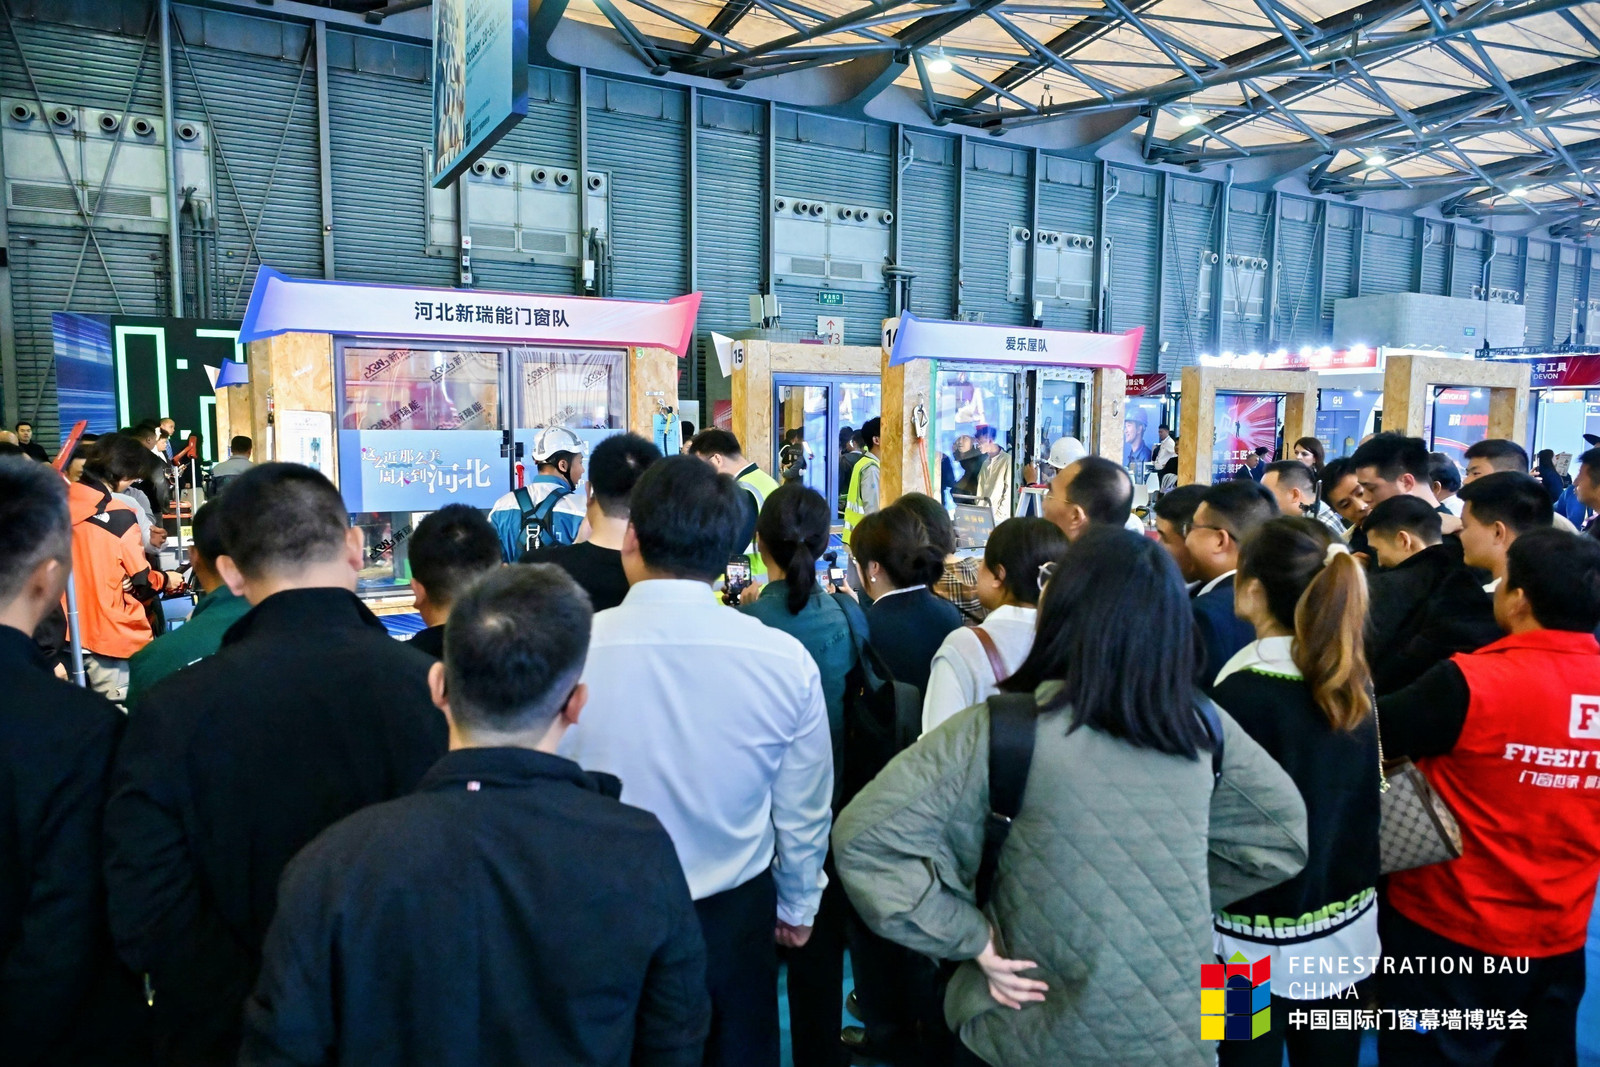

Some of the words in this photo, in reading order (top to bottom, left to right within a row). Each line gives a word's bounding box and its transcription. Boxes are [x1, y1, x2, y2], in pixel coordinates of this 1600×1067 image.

[414, 301, 570, 328] 河北新瑞能门窗队
[1005, 336, 1049, 353] 爱乐屋队
[733, 348, 744, 364] 15
[360, 447, 442, 469] 这么近那么美
[379, 458, 492, 494] 周末到河北
[1519, 770, 1579, 789] 门窗世家
